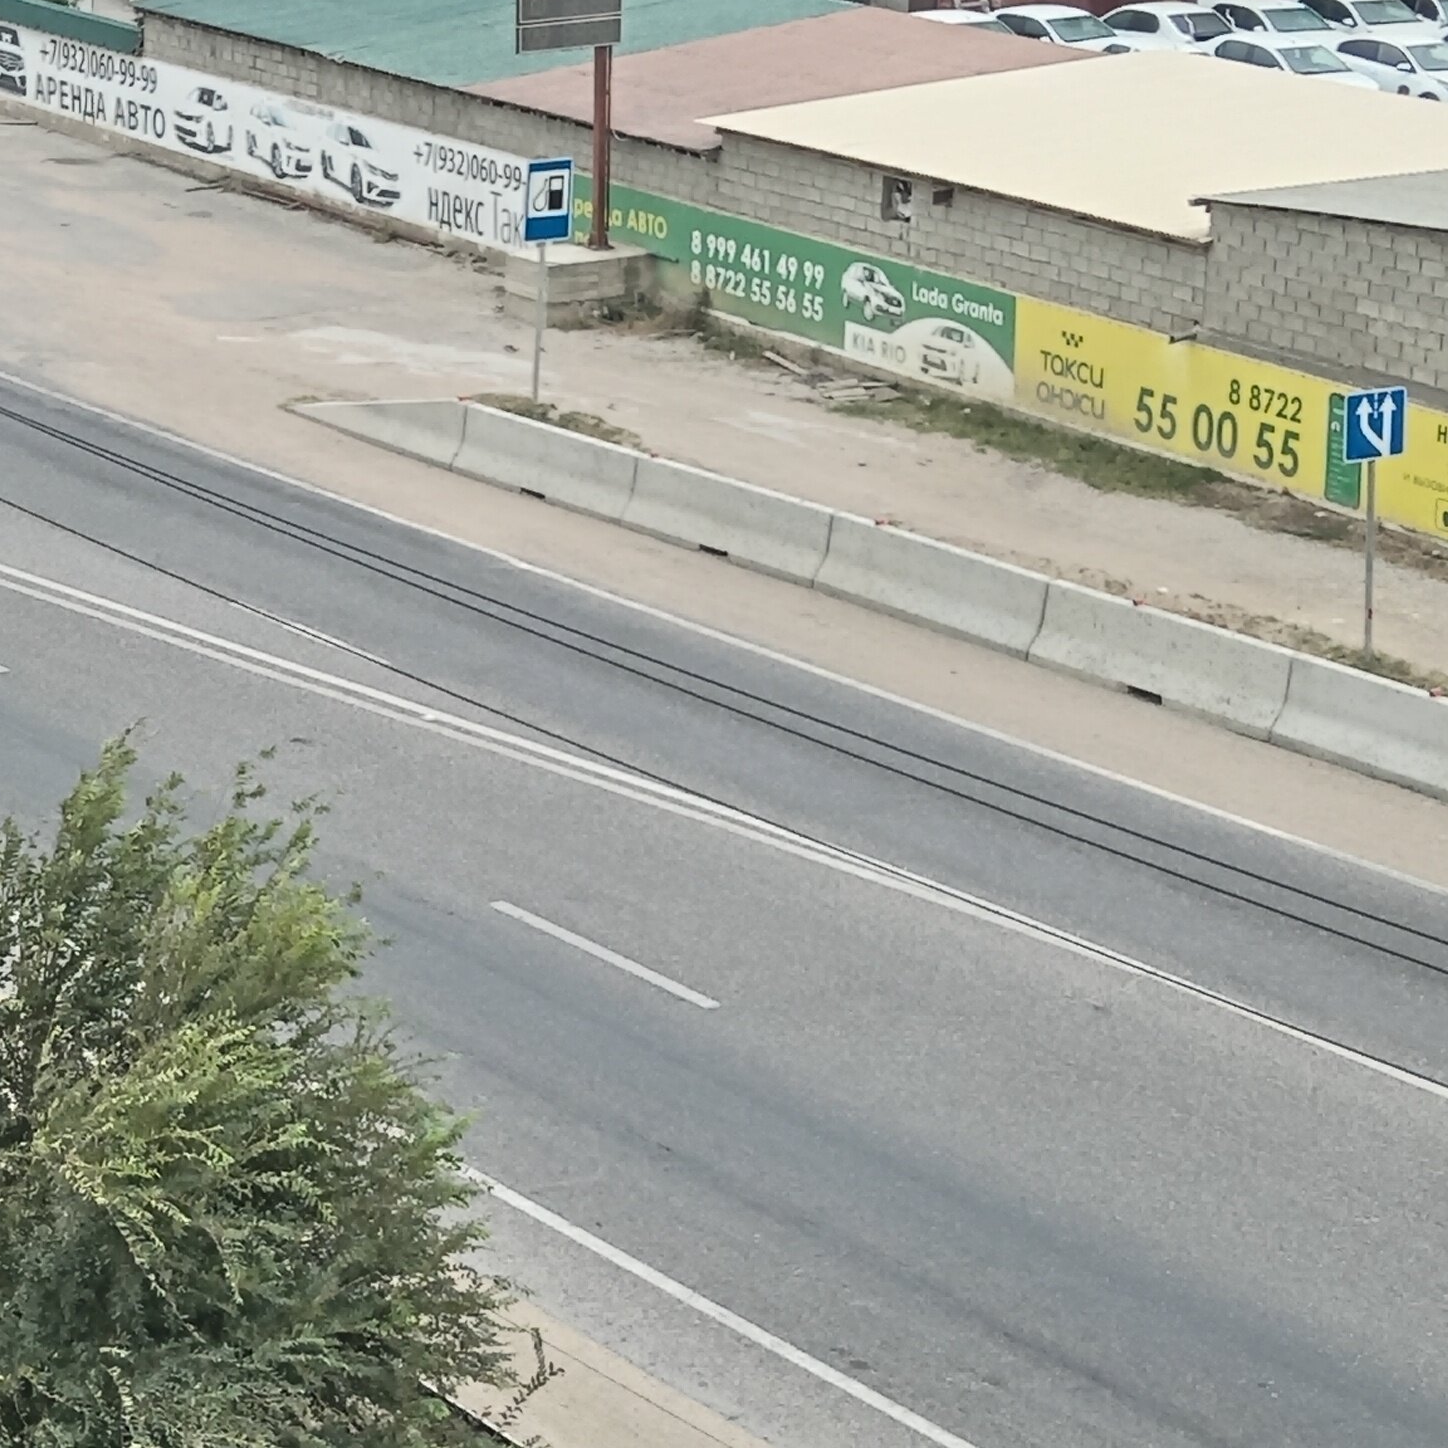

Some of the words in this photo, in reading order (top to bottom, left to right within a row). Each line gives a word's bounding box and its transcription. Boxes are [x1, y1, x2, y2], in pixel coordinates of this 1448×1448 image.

[40, 39, 157, 93] +7(932)060-99-99
[35, 72, 107, 126] АРЕНДА
[114, 97, 166, 139] АВТО
[413, 142, 526, 191] +7(932)060-99-
[490, 191, 526, 249] Так
[626, 209, 667, 239] АВТО
[691, 230, 702, 255] 8
[706, 234, 736, 263] 999
[740, 244, 770, 274] 461
[776, 254, 798, 282] 49
[804, 261, 824, 290] 99
[691, 260, 701, 285] 8
[705, 264, 746, 297] 8722
[750, 277, 771, 306] 55
[776, 285, 796, 314] 56
[802, 292, 824, 322] 55
[912, 281, 948, 309] Lada
[951, 294, 1004, 326] Granta
[852, 331, 875, 354] KIA
[880, 338, 906, 364] RIO
[1229, 379, 1241, 405] 8
[1249, 384, 1302, 424] 8722
[1133, 386, 1177, 440] 55
[1192, 403, 1238, 459] 00
[1253, 422, 1300, 478] 55
